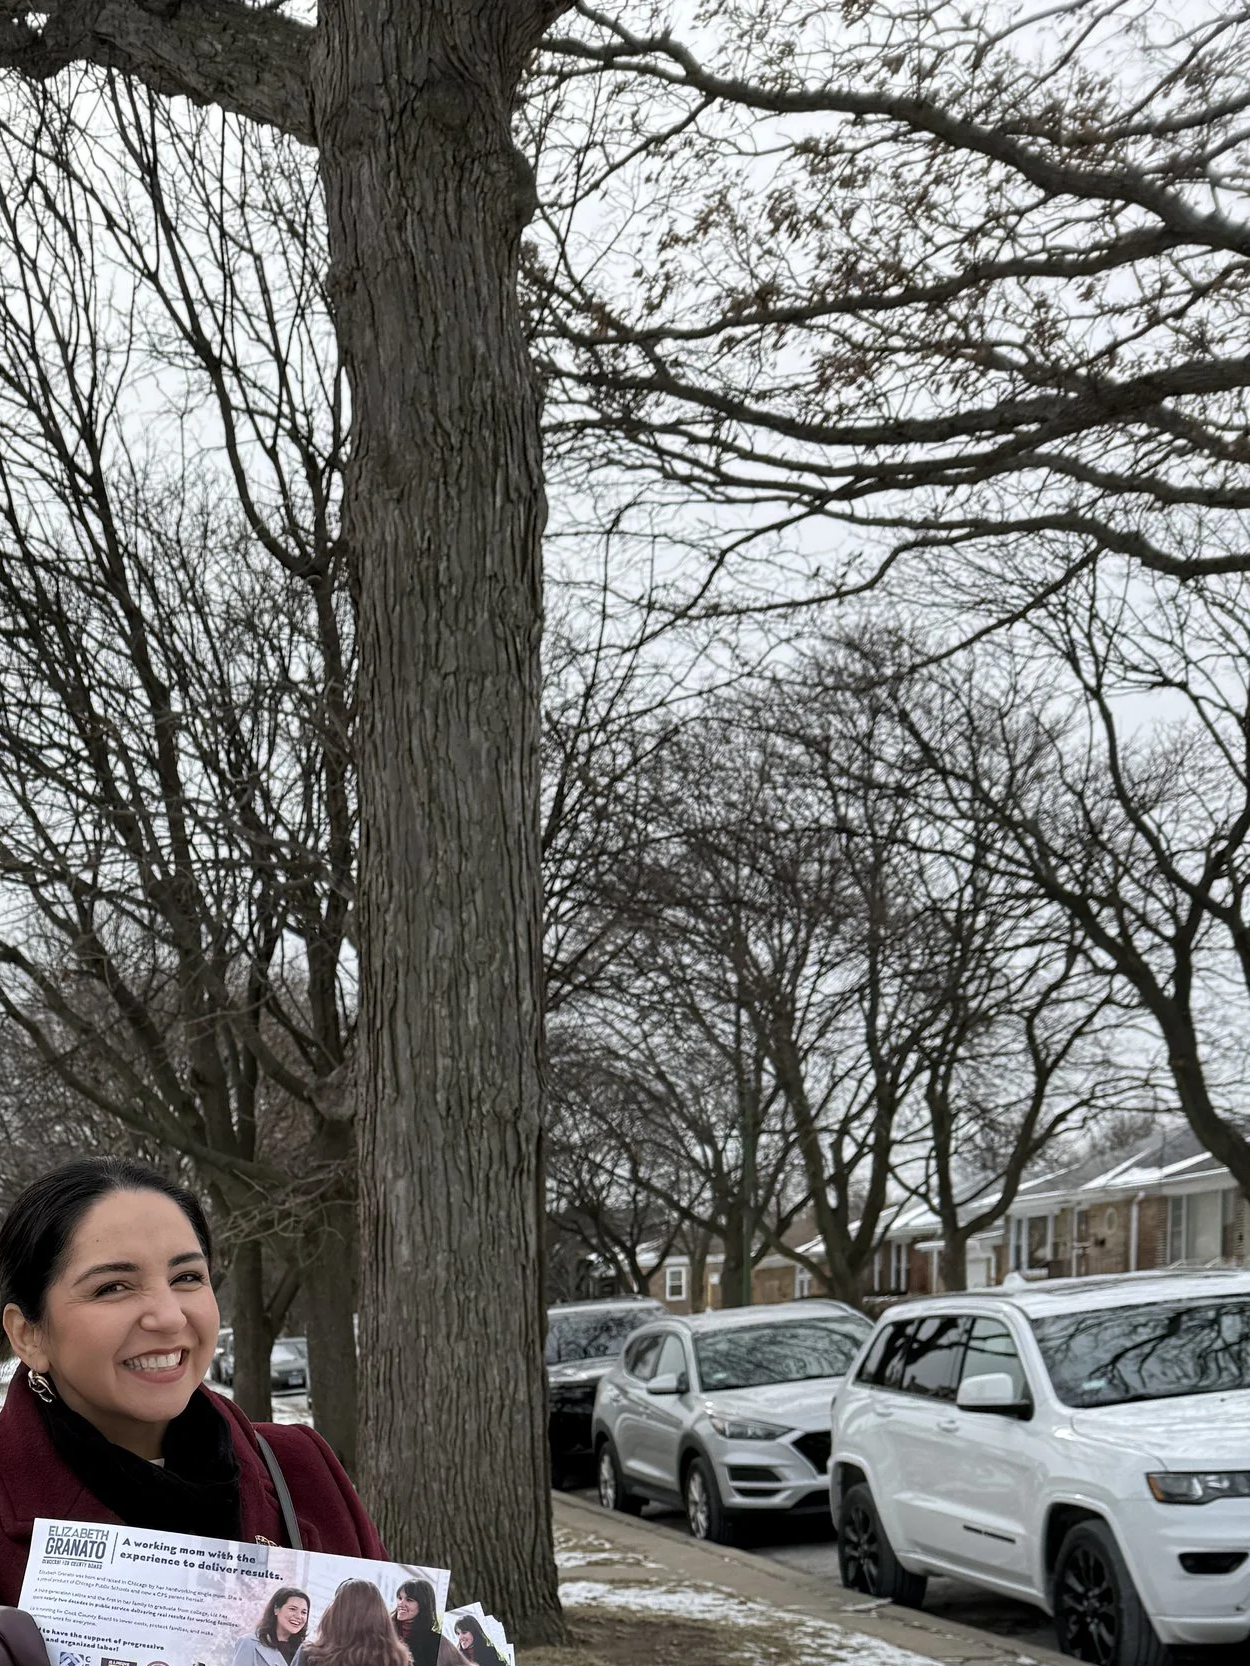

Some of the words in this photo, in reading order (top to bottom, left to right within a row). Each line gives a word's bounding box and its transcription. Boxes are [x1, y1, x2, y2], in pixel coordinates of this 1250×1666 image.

[48, 1525, 110, 1541] ELIZABETH
[44, 1537, 107, 1560] GRANATO
[121, 1537, 131, 1547] A
[133, 1541, 177, 1555] working
[179, 1547, 205, 1557] mom
[208, 1550, 234, 1561] with
[236, 1553, 256, 1564] the
[119, 1551, 180, 1566] experience
[182, 1559, 195, 1568] to
[197, 1561, 238, 1574] deliver
[240, 1569, 284, 1581] results.
[42, 1627, 51, 1635] to
[51, 1628, 69, 1637] have
[69, 1630, 83, 1639] the
[83, 1634, 112, 1644] support
[122, 1639, 165, 1651] progressive
[60, 1639, 96, 1649] organized
[96, 1643, 119, 1652] labor!
